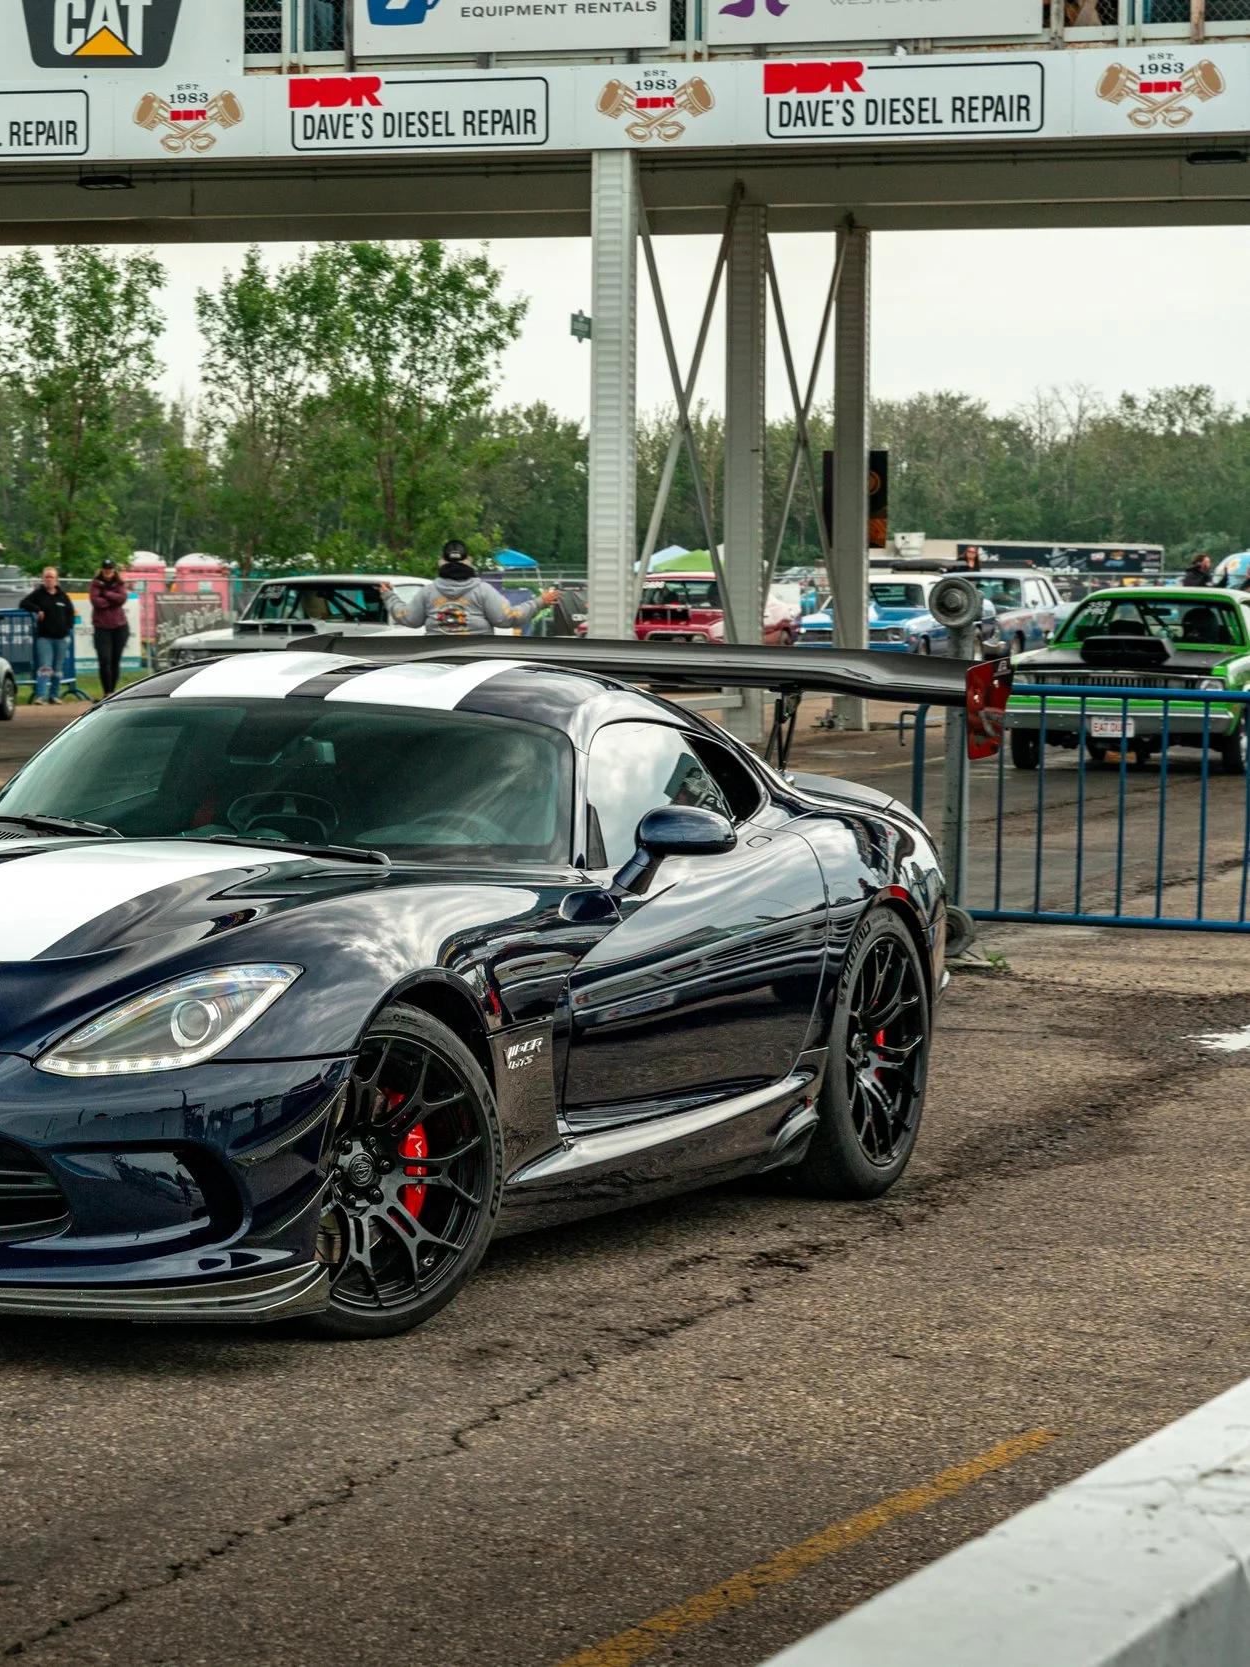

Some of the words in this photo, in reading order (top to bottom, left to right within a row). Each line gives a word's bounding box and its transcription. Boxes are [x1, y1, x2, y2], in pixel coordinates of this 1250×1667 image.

[461, 4, 568, 18] EQUIPMENT
[574, 1, 657, 14] RENTALS
[53, 0, 153, 56] CAT
[763, 61, 865, 94] DDR
[1138, 62, 1184, 75] 1983
[170, 92, 208, 104] 1983
[289, 76, 381, 108] DDR
[634, 79, 677, 91] 1983
[303, 112, 374, 141] DAVE'S
[383, 110, 456, 139] DIESEL
[463, 108, 537, 137] REPAIR
[778, 98, 855, 128] DAVE'S
[865, 96, 944, 126] DIESEL
[951, 94, 1031, 124] REPAIR
[10, 120, 78, 147] REPAIR
